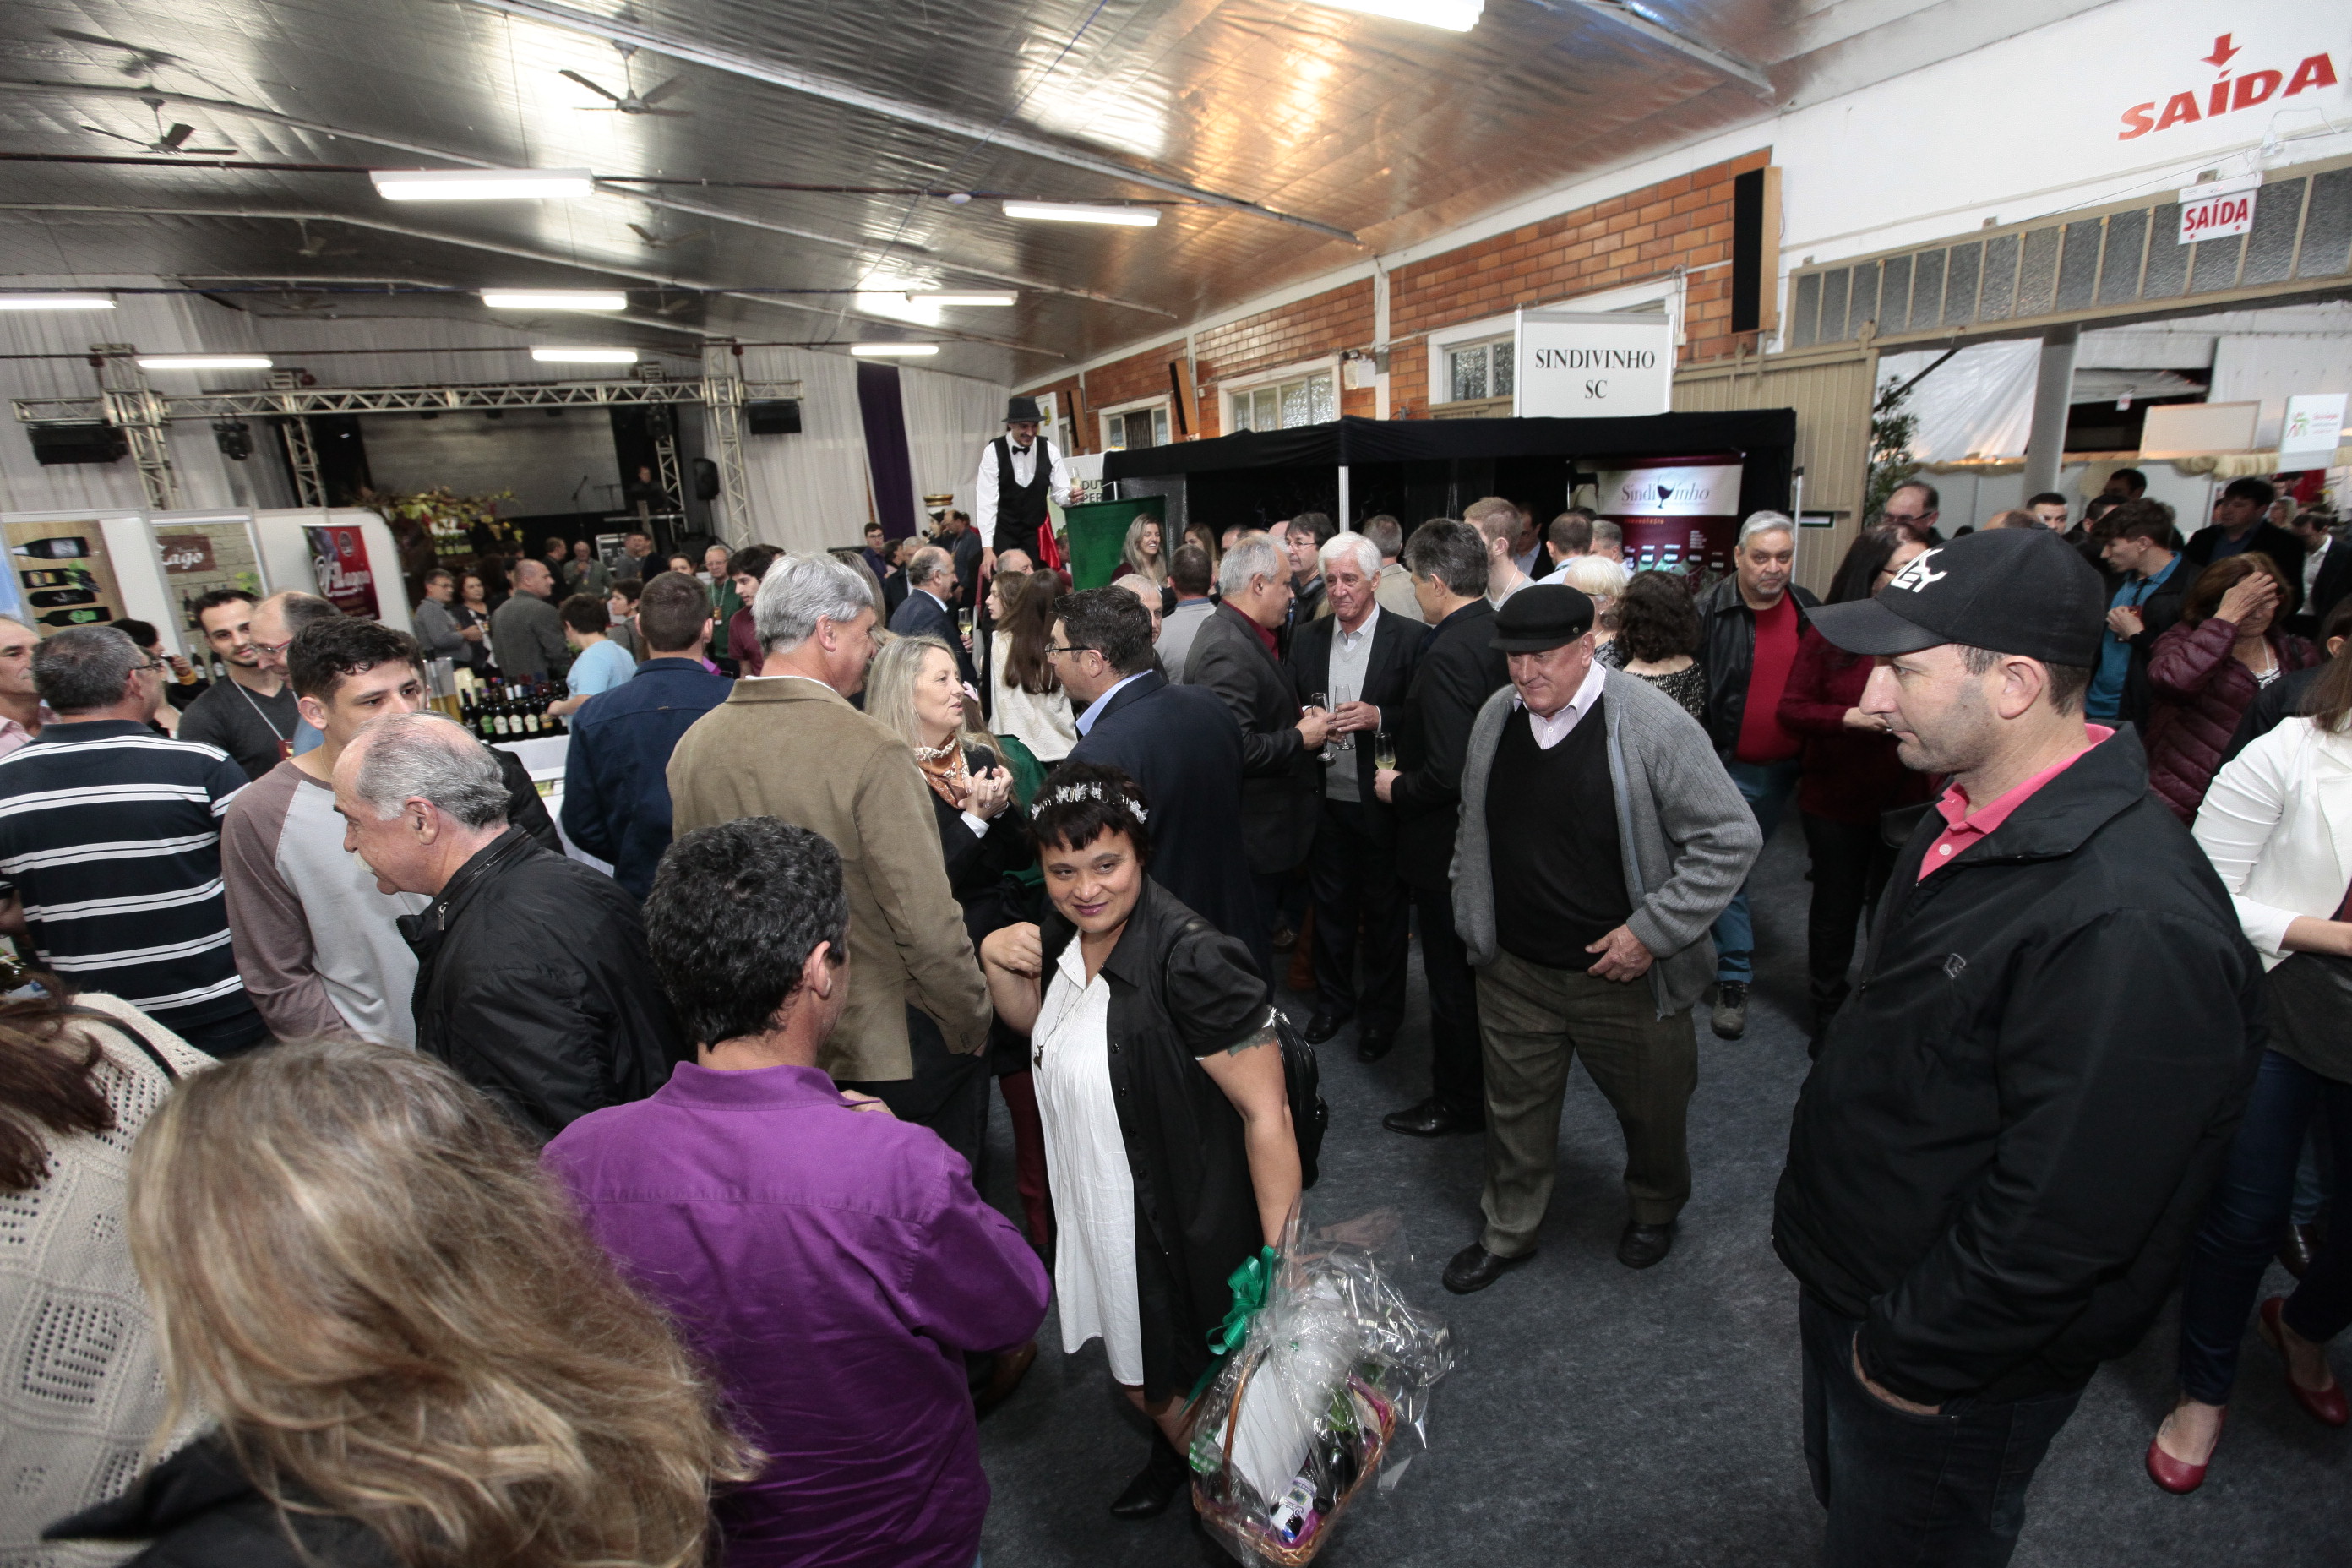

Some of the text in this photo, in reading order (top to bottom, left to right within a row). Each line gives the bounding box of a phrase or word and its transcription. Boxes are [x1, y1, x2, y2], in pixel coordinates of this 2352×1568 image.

[2117, 52, 2338, 141] SAÍDA
[2183, 198, 2248, 232] SAÍDA
[1535, 348, 1656, 369] SINDIVINHO
[1584, 379, 1608, 399] SC
